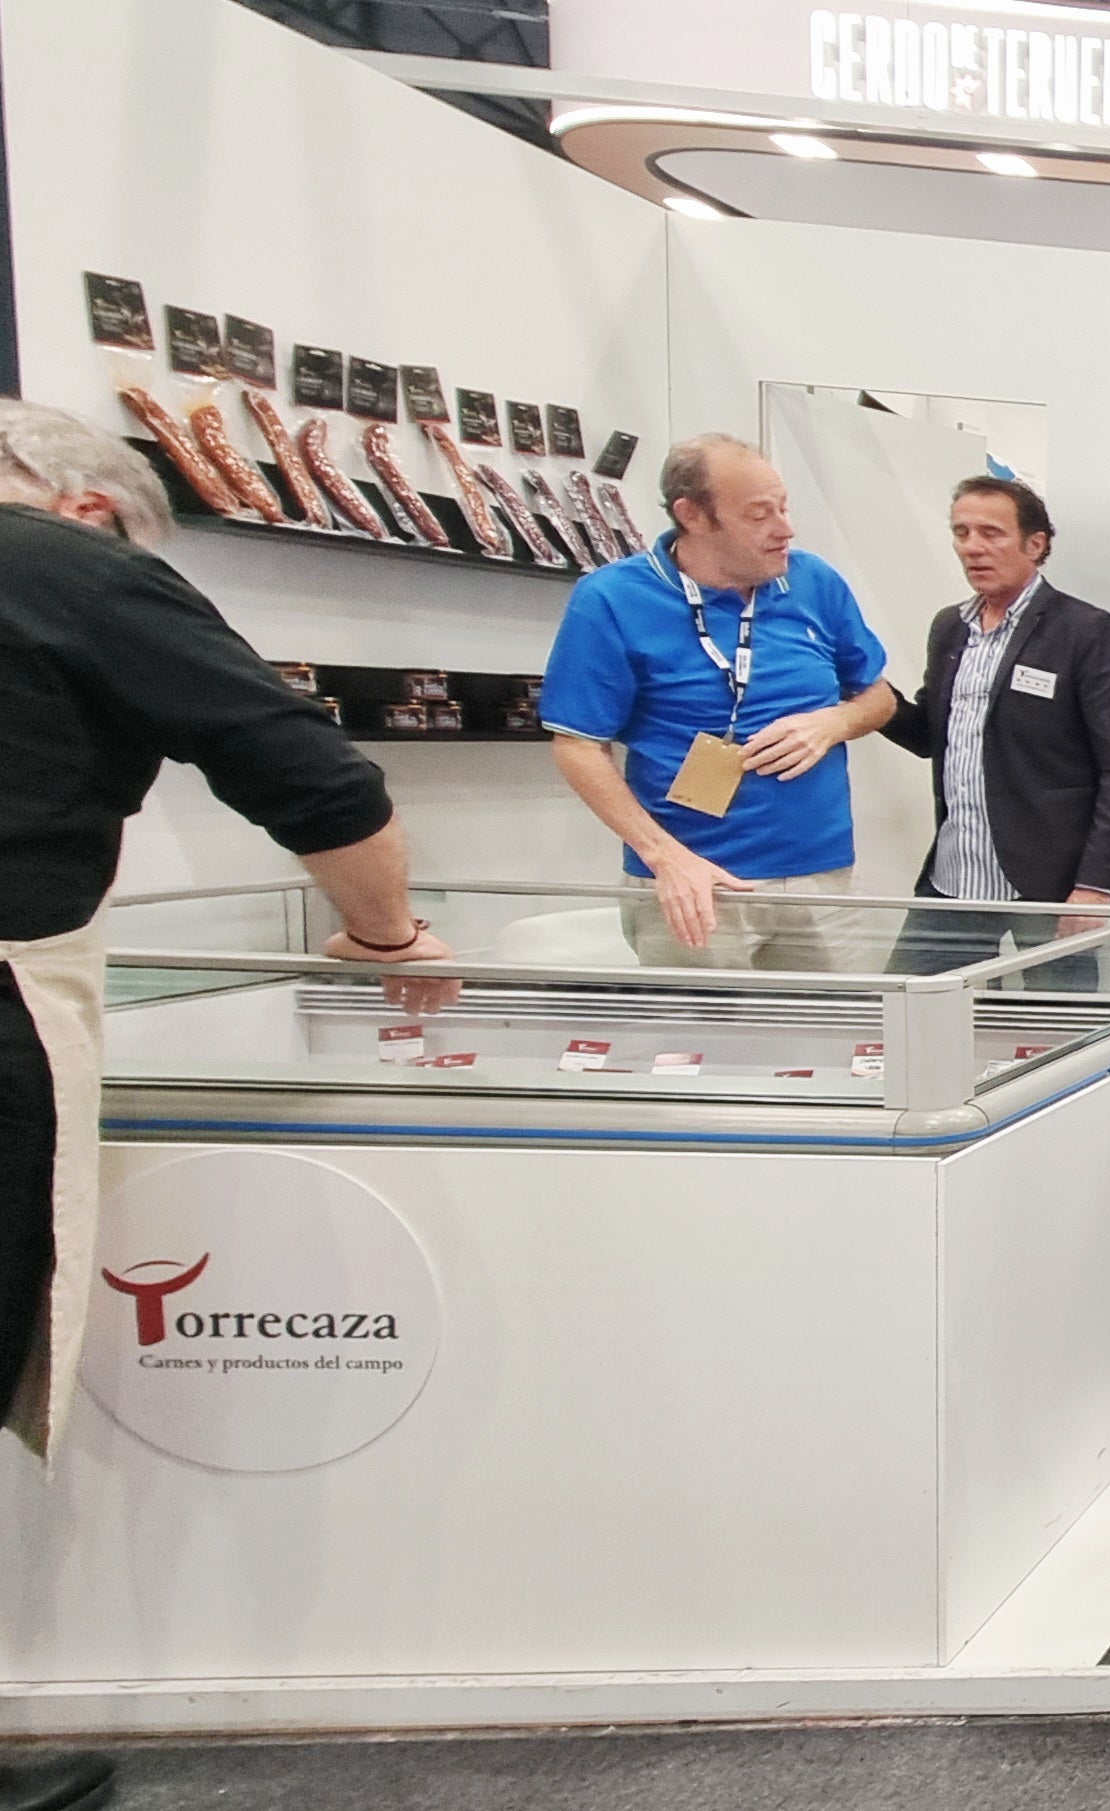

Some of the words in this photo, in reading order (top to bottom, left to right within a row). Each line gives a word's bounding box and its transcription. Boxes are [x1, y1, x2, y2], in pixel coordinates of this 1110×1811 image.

[809, 9, 950, 111] CERDO
[101, 1252, 400, 1346] Torrecaza
[138, 1353, 202, 1370] Carnes
[207, 1358, 217, 1375] y
[222, 1354, 309, 1374] productos
[313, 1354, 341, 1371] del
[345, 1358, 404, 1374] campo
